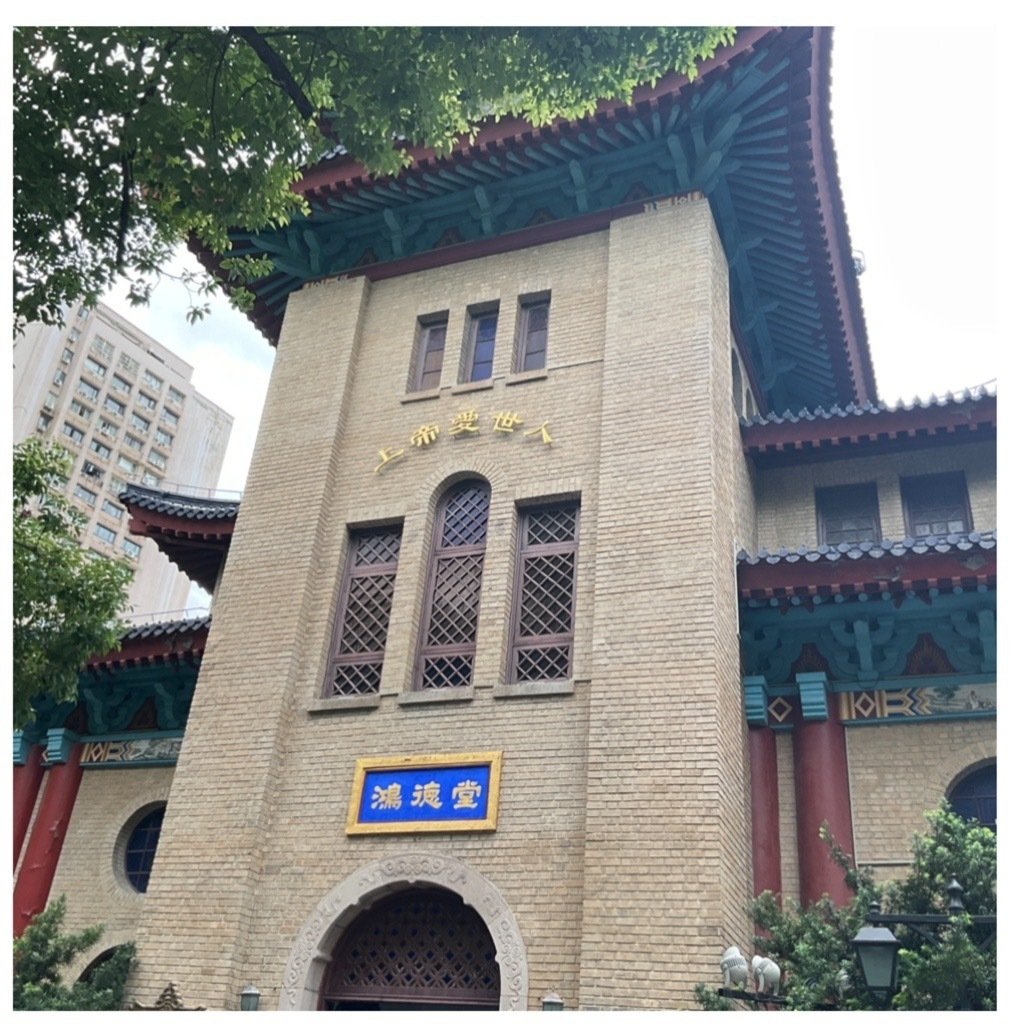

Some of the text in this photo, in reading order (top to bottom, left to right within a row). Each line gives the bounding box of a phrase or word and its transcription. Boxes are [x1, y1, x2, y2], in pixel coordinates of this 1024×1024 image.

[375, 409, 553, 474] 上帝愛世人
